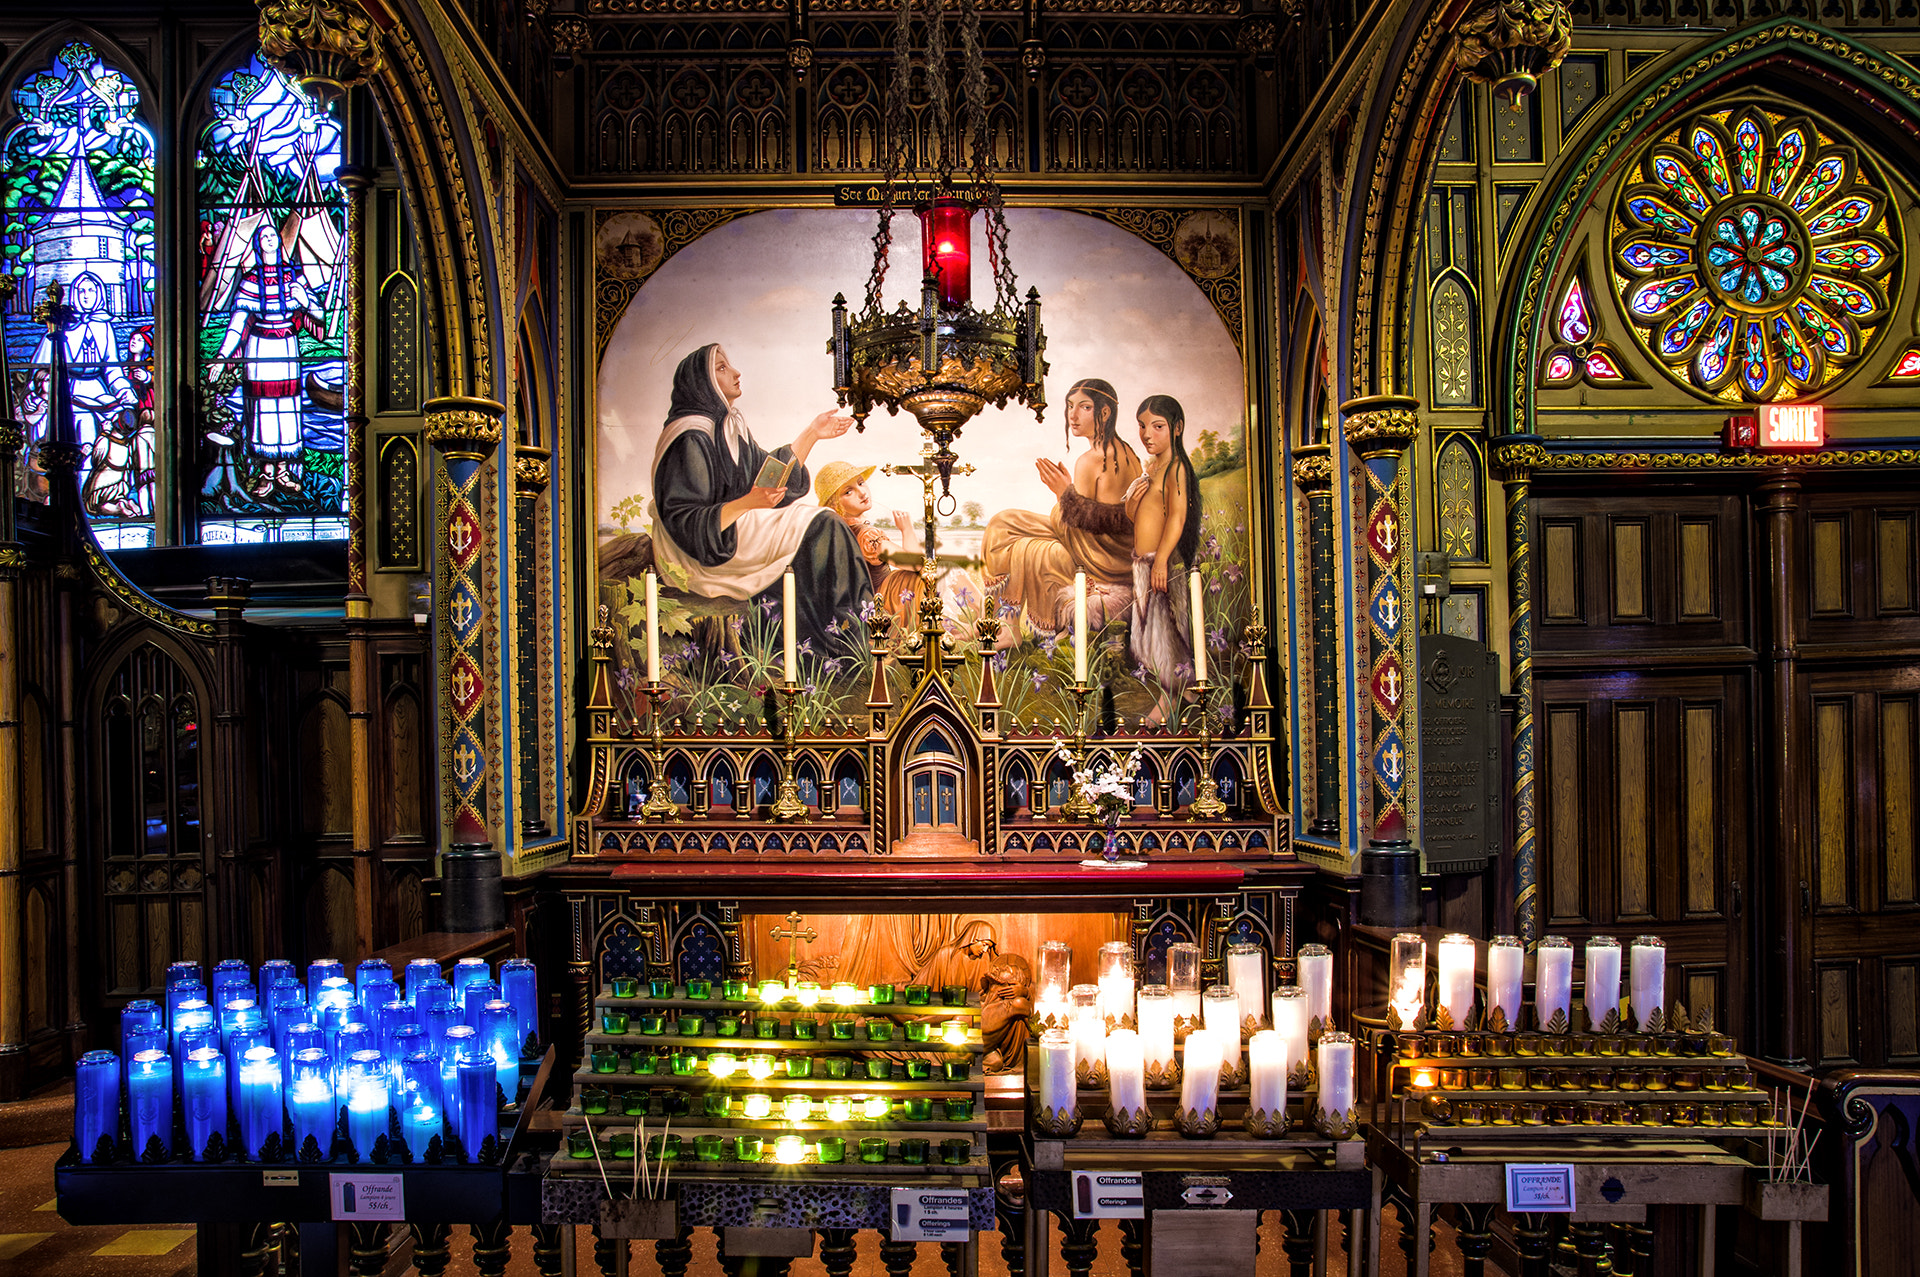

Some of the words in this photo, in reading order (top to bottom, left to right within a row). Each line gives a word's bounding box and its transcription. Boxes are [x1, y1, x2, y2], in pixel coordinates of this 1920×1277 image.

[839, 186, 862, 201] Ste
[866, 186, 931, 204] Maguerite
[1769, 406, 1819, 442] SORTIE
[1421, 698, 1431, 709] A
[1435, 698, 1476, 709] MEMOIRE
[1521, 1176, 1562, 1185] OFFRANDE
[361, 1184, 393, 1195] Offrande
[921, 1196, 963, 1204] Offrandes
